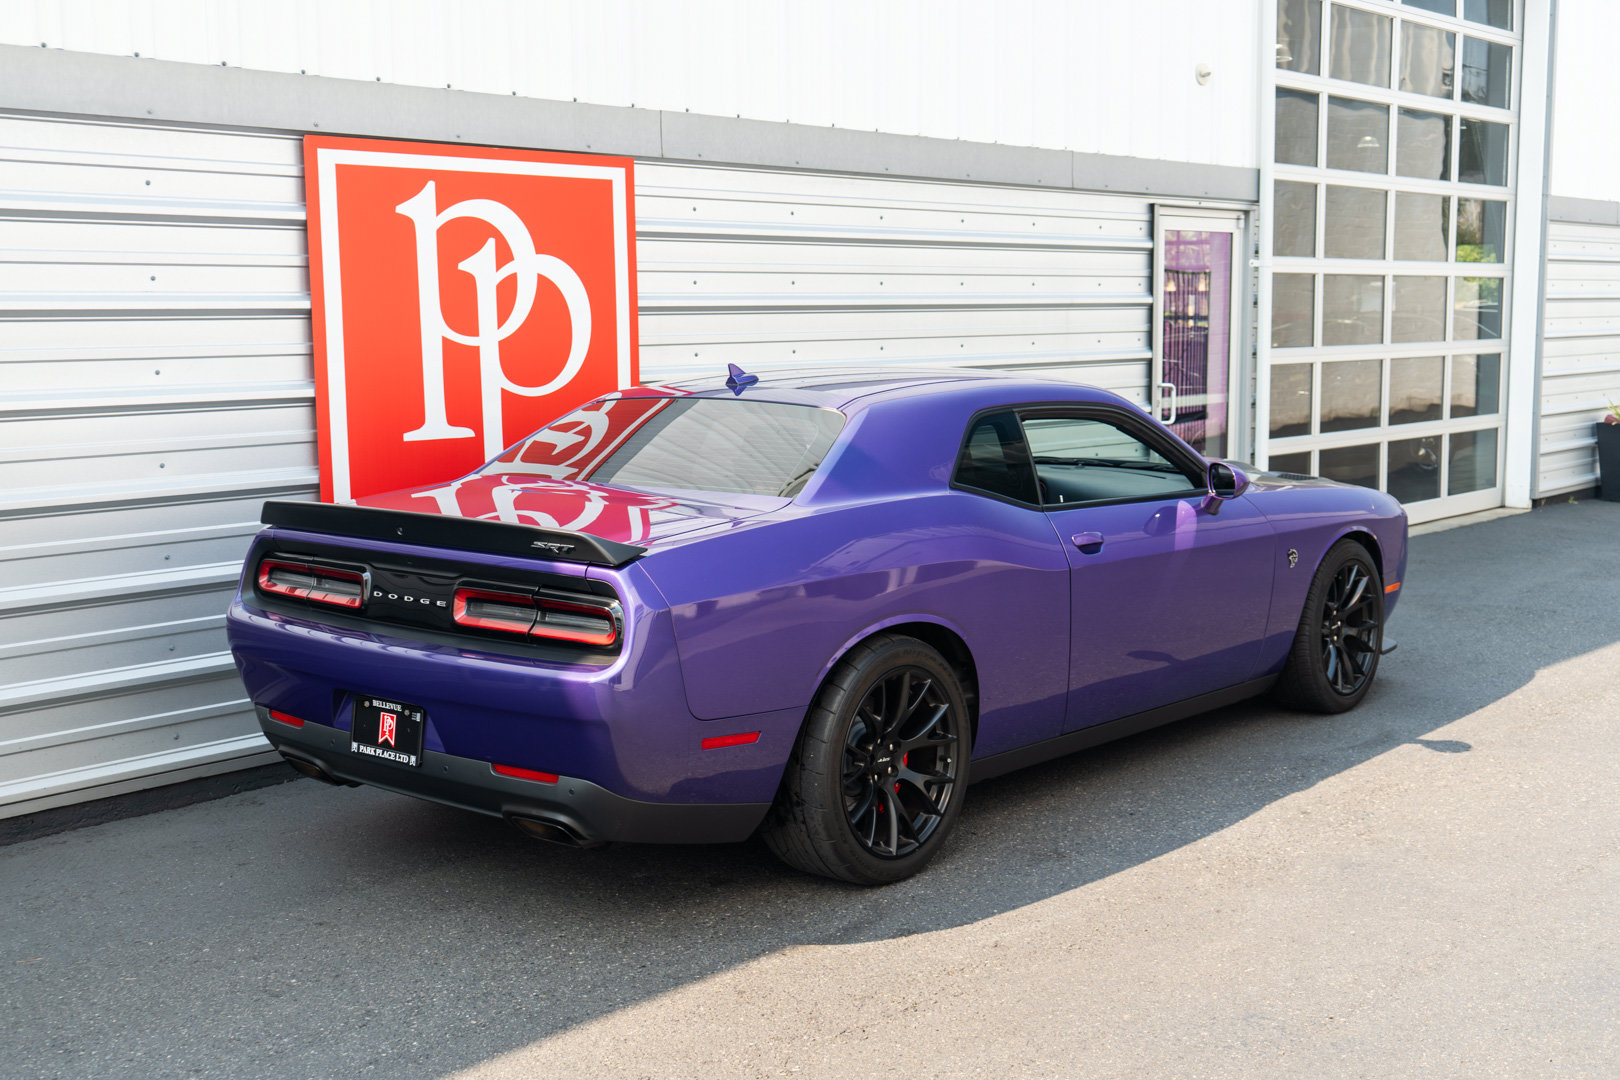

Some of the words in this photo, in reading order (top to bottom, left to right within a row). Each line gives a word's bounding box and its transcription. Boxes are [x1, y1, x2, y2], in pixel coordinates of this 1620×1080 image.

[531, 541, 575, 553] SRT
[373, 591, 446, 606] DODGE
[372, 699, 402, 711] BELLEVUE
[359, 745, 375, 755] PARK
[376, 749, 395, 760] PLACE
[396, 754, 409, 763] LTD
